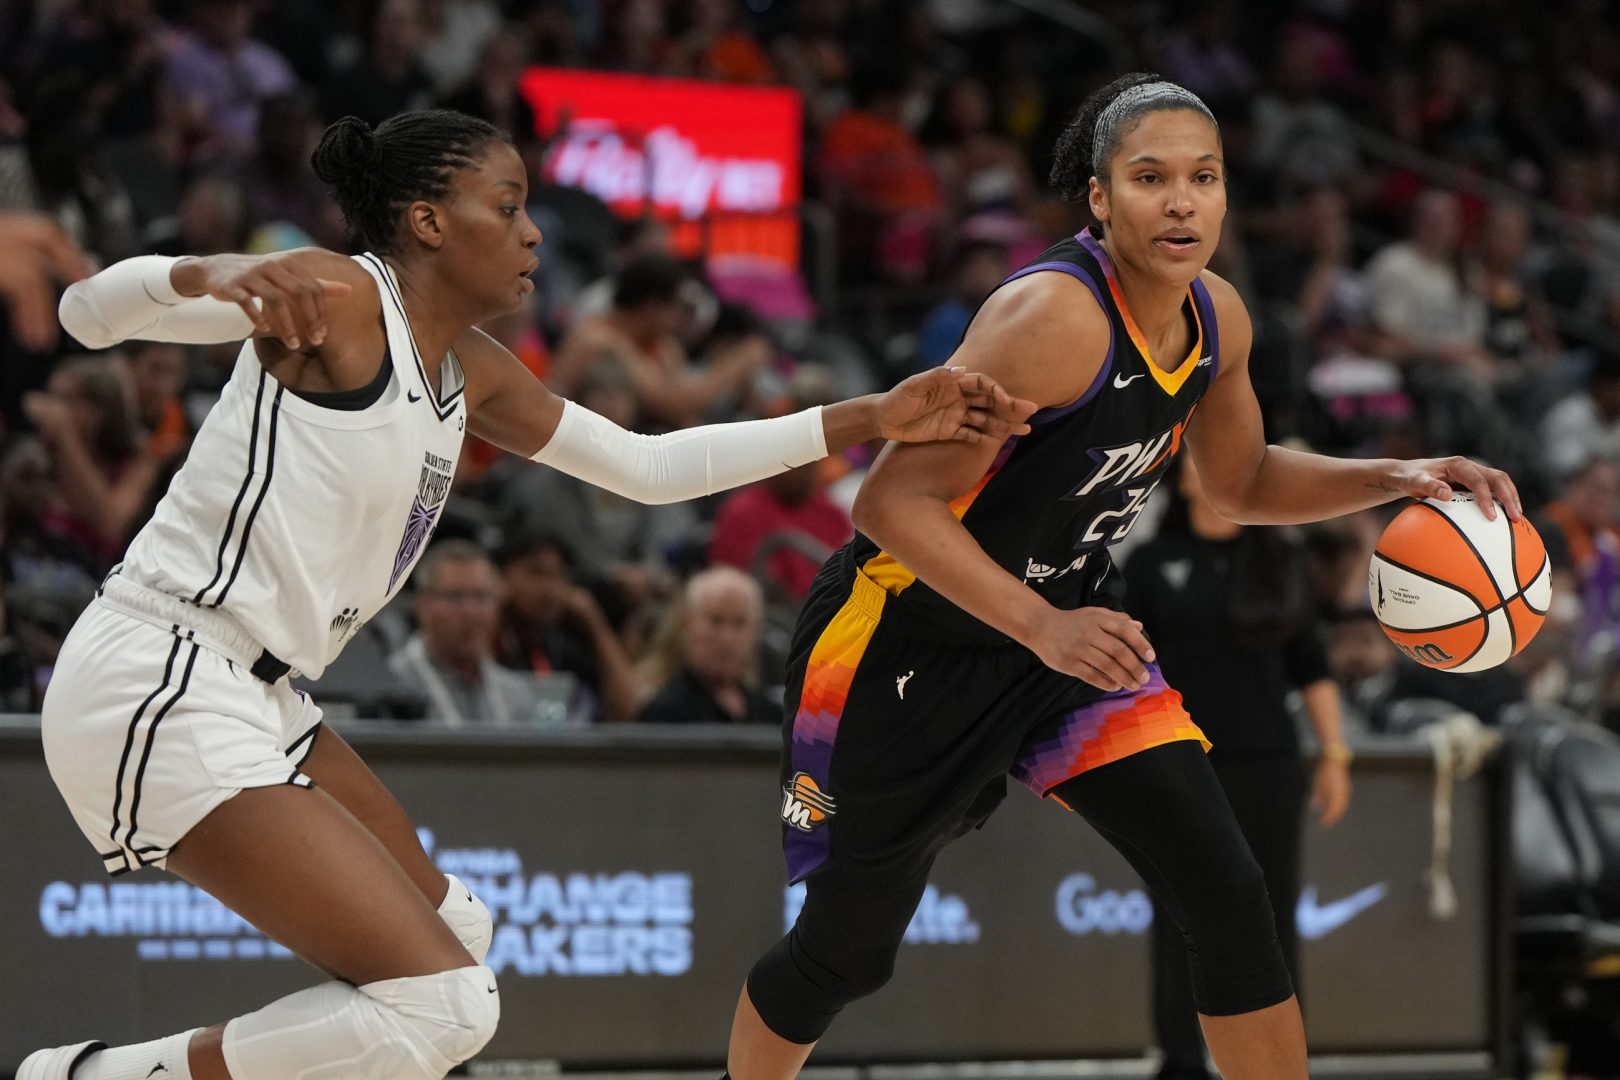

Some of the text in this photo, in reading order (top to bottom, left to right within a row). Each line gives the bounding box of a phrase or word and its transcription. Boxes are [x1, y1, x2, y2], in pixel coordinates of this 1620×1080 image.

[425, 451, 452, 473] GOLDEN STATE
[1081, 478, 1161, 543] 25
[456, 871, 693, 926] HANGE
[1056, 872, 1155, 936] Goo
[484, 924, 693, 977] AKERS
